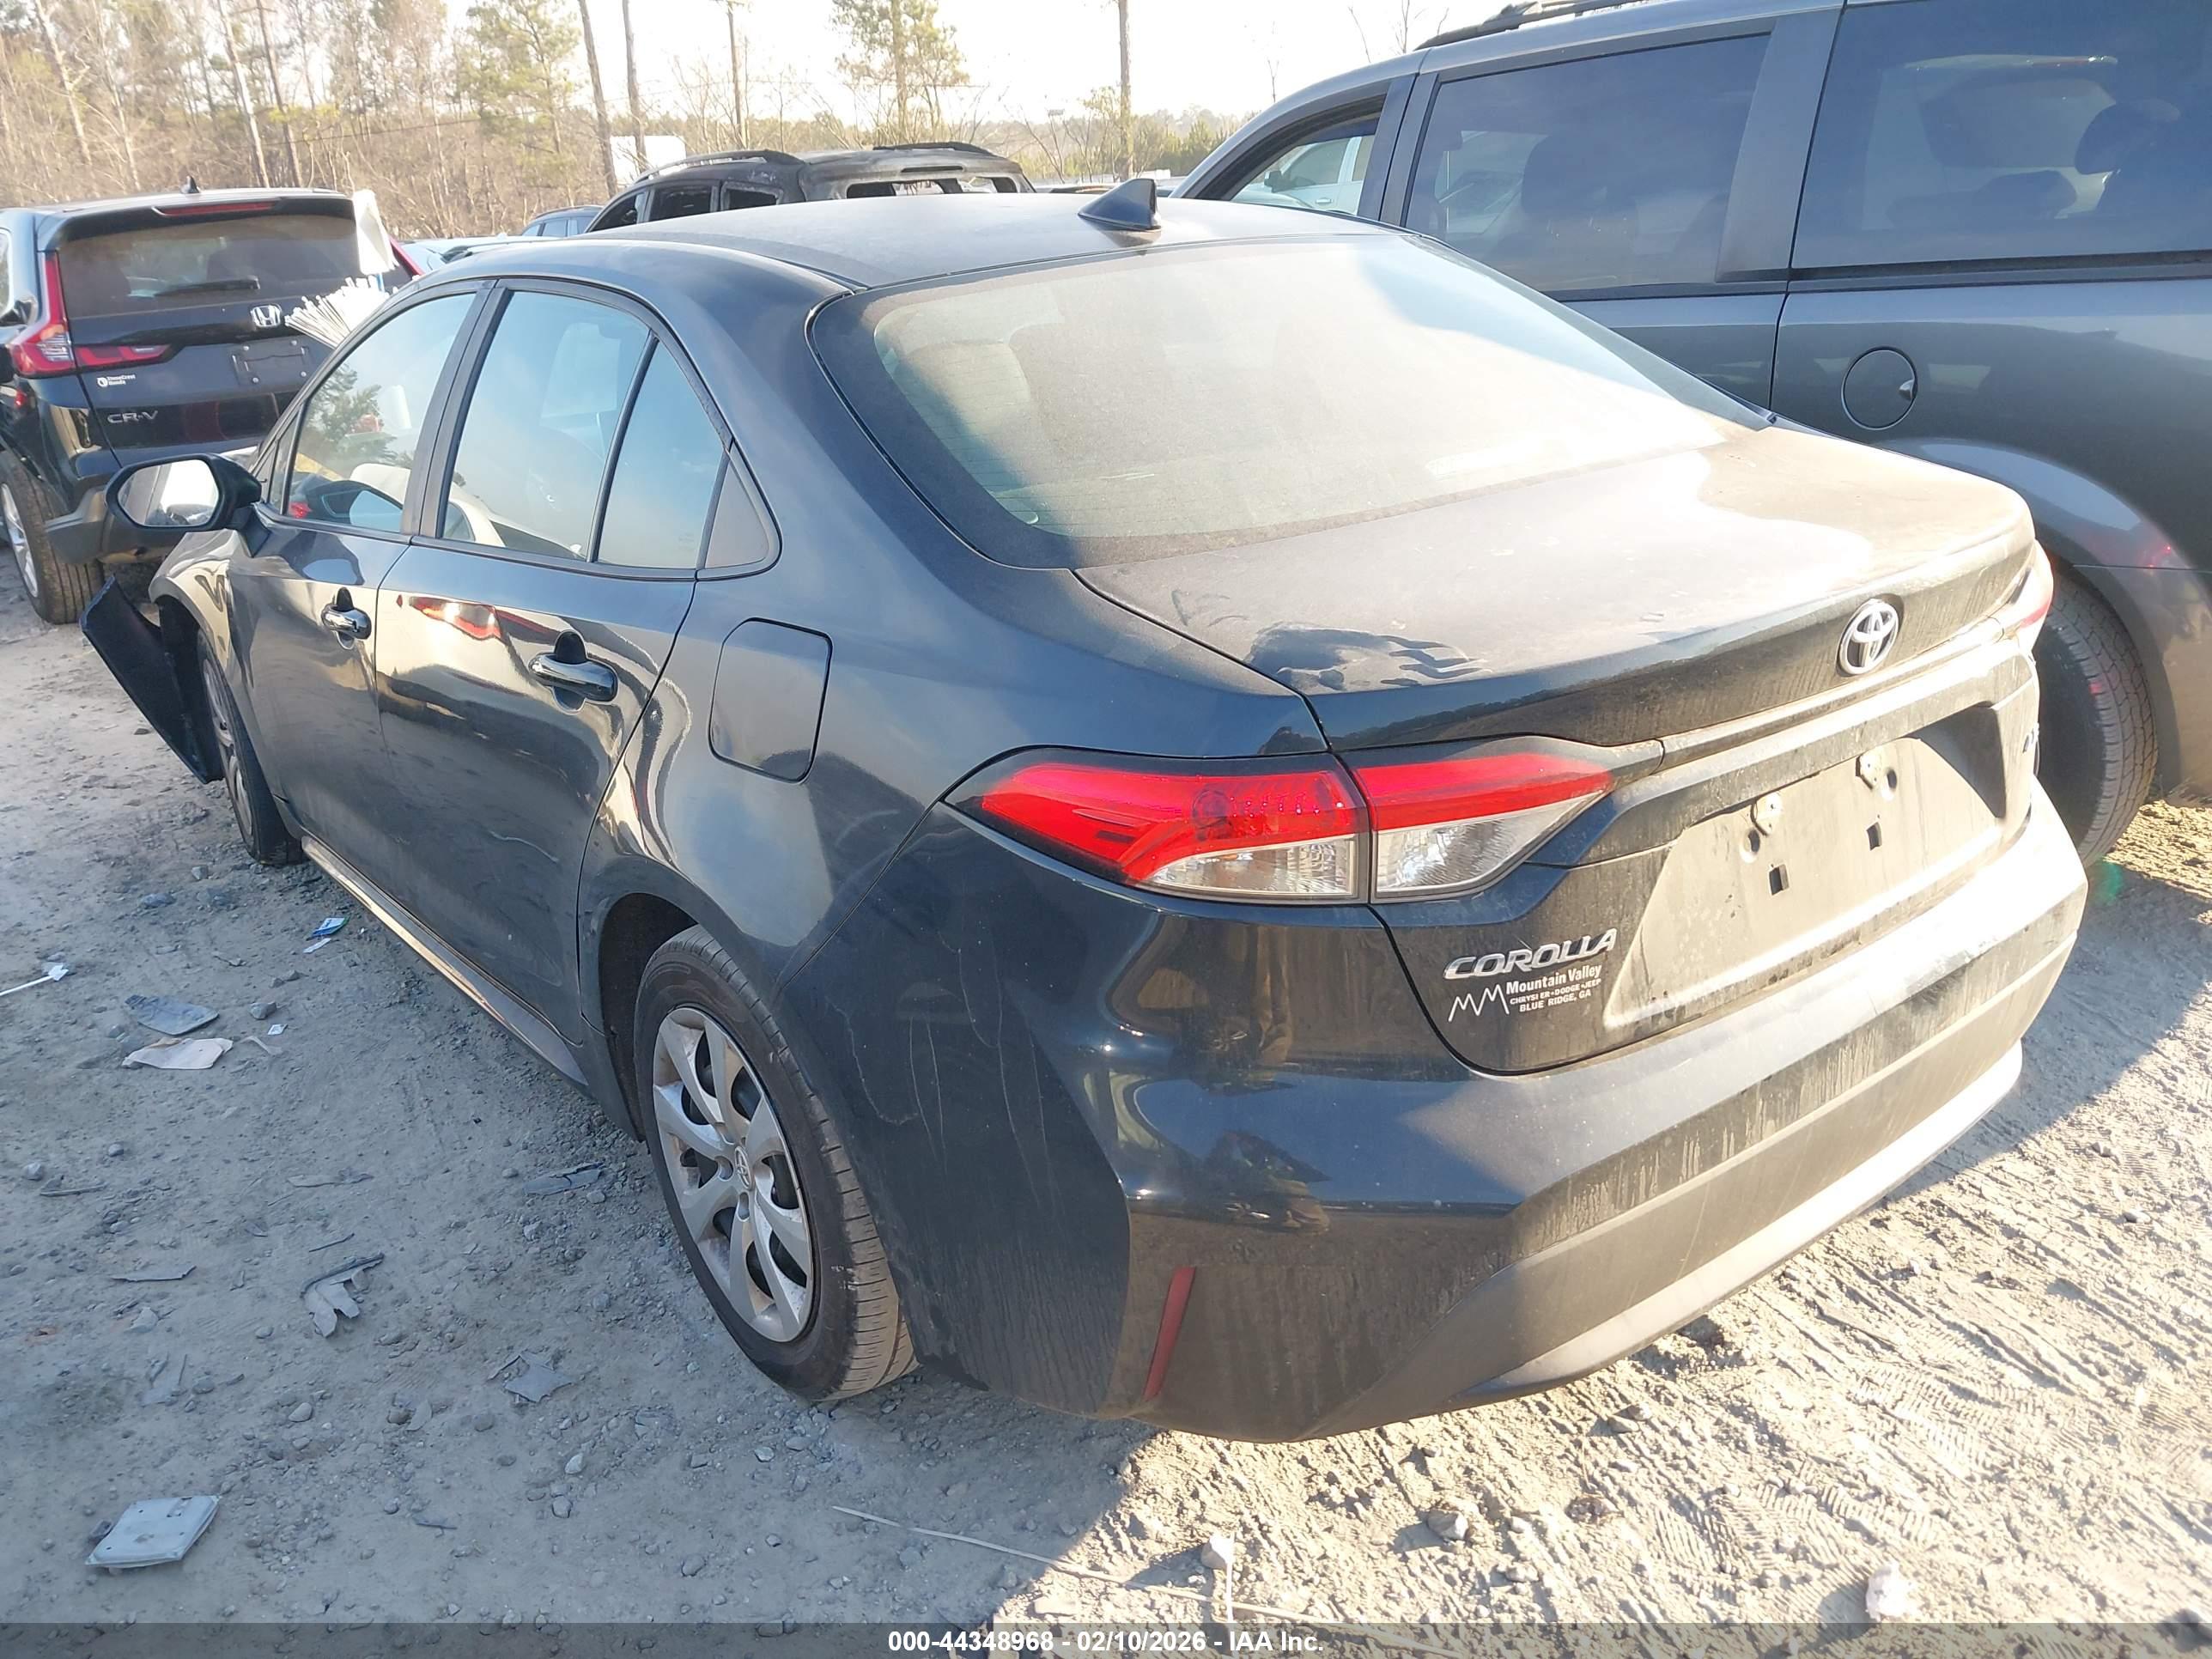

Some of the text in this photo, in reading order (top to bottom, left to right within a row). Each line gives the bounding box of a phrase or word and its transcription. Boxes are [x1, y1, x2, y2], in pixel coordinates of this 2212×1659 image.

[107, 410, 158, 423] CR-V
[1443, 928, 1618, 980] COROLLA
[1506, 964, 1602, 994] Mountain Valley
[1519, 1000, 1545, 1012] BLUE
[1578, 988, 1592, 999] GA
